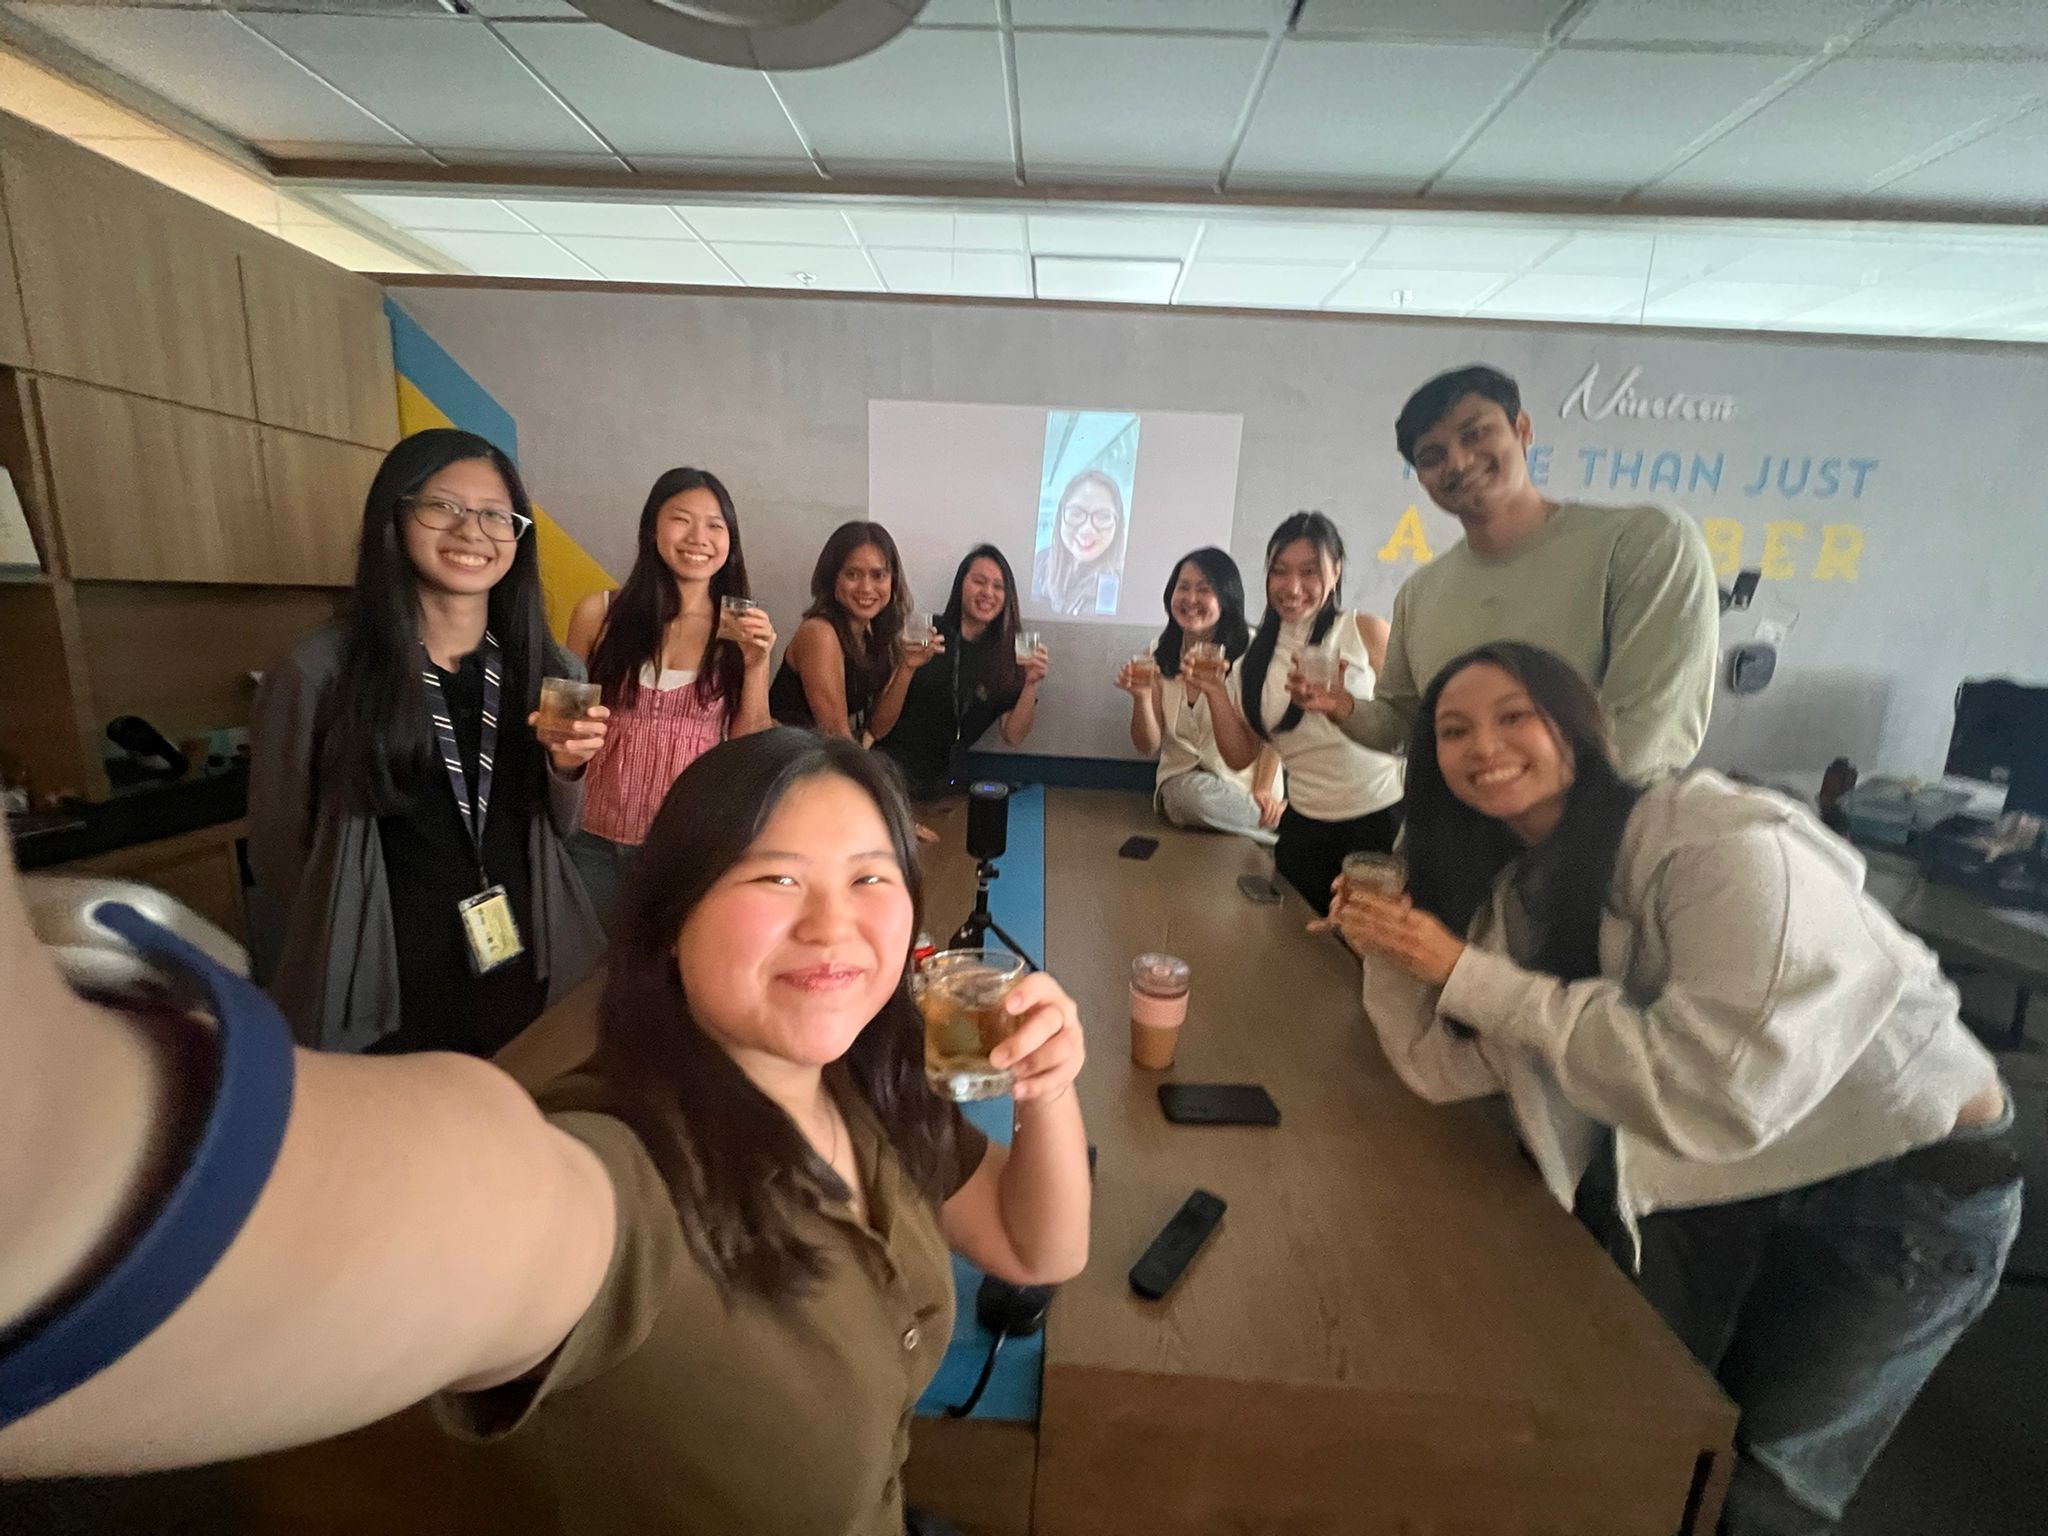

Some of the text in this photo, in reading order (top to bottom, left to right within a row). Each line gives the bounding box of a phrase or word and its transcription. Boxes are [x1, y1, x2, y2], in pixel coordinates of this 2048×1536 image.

[1578, 446, 1725, 496] THAN
[1743, 454, 1880, 499] JUST
[1377, 503, 1864, 582] A BER
